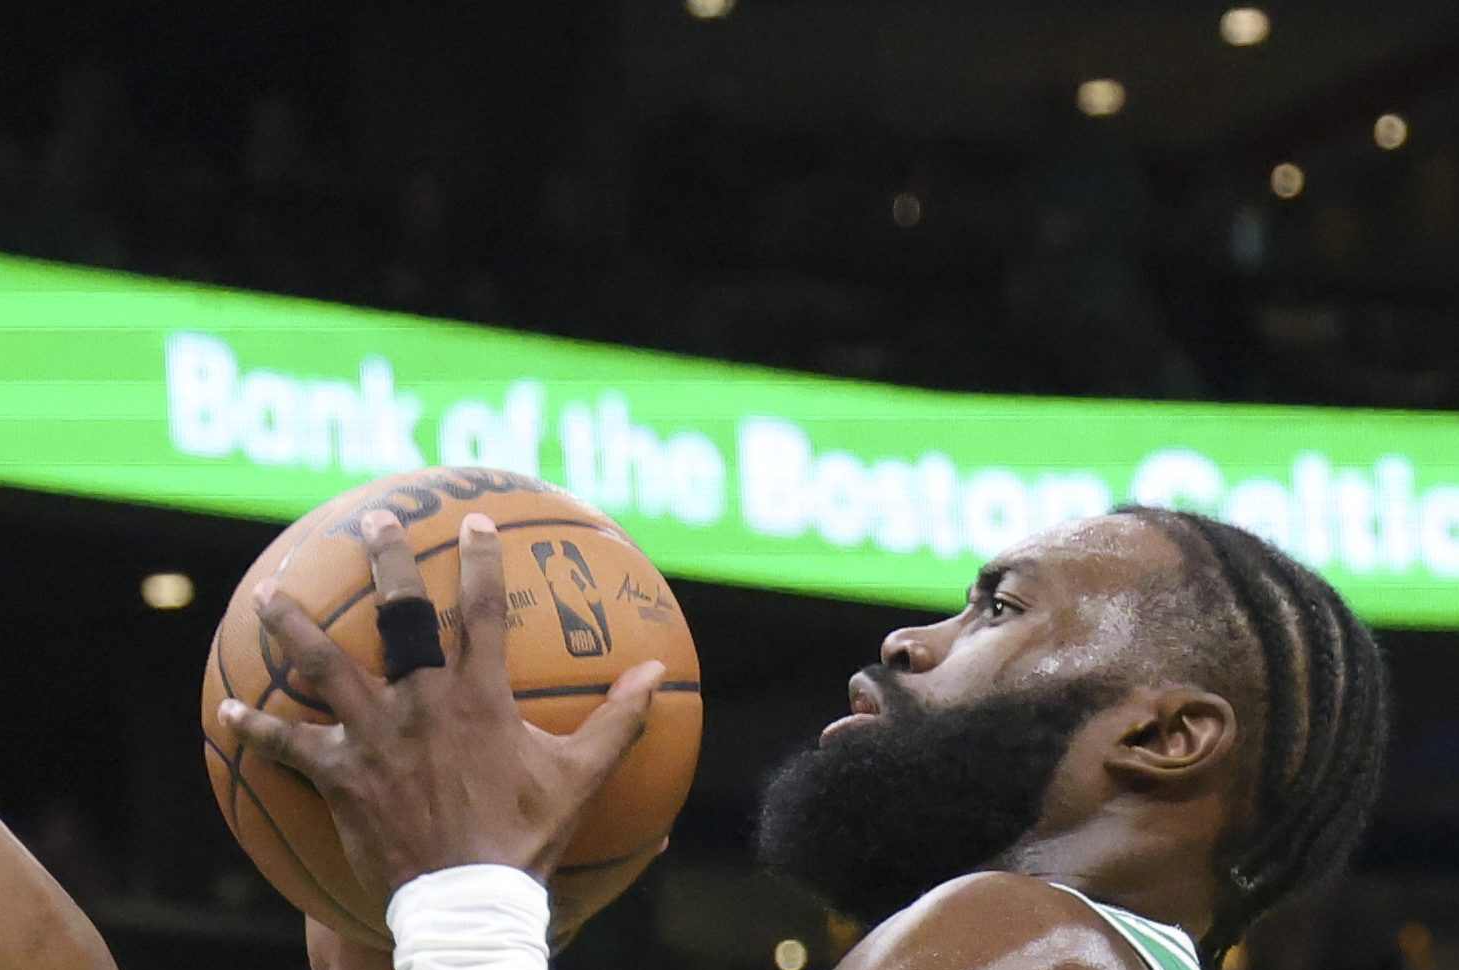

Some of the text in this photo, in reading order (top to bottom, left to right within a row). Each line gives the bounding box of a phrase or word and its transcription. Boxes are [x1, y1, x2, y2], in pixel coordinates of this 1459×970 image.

[164, 330, 428, 477] Bank
[439, 377, 548, 478] of
[560, 385, 729, 528] the
[569, 629, 597, 653] NBA
